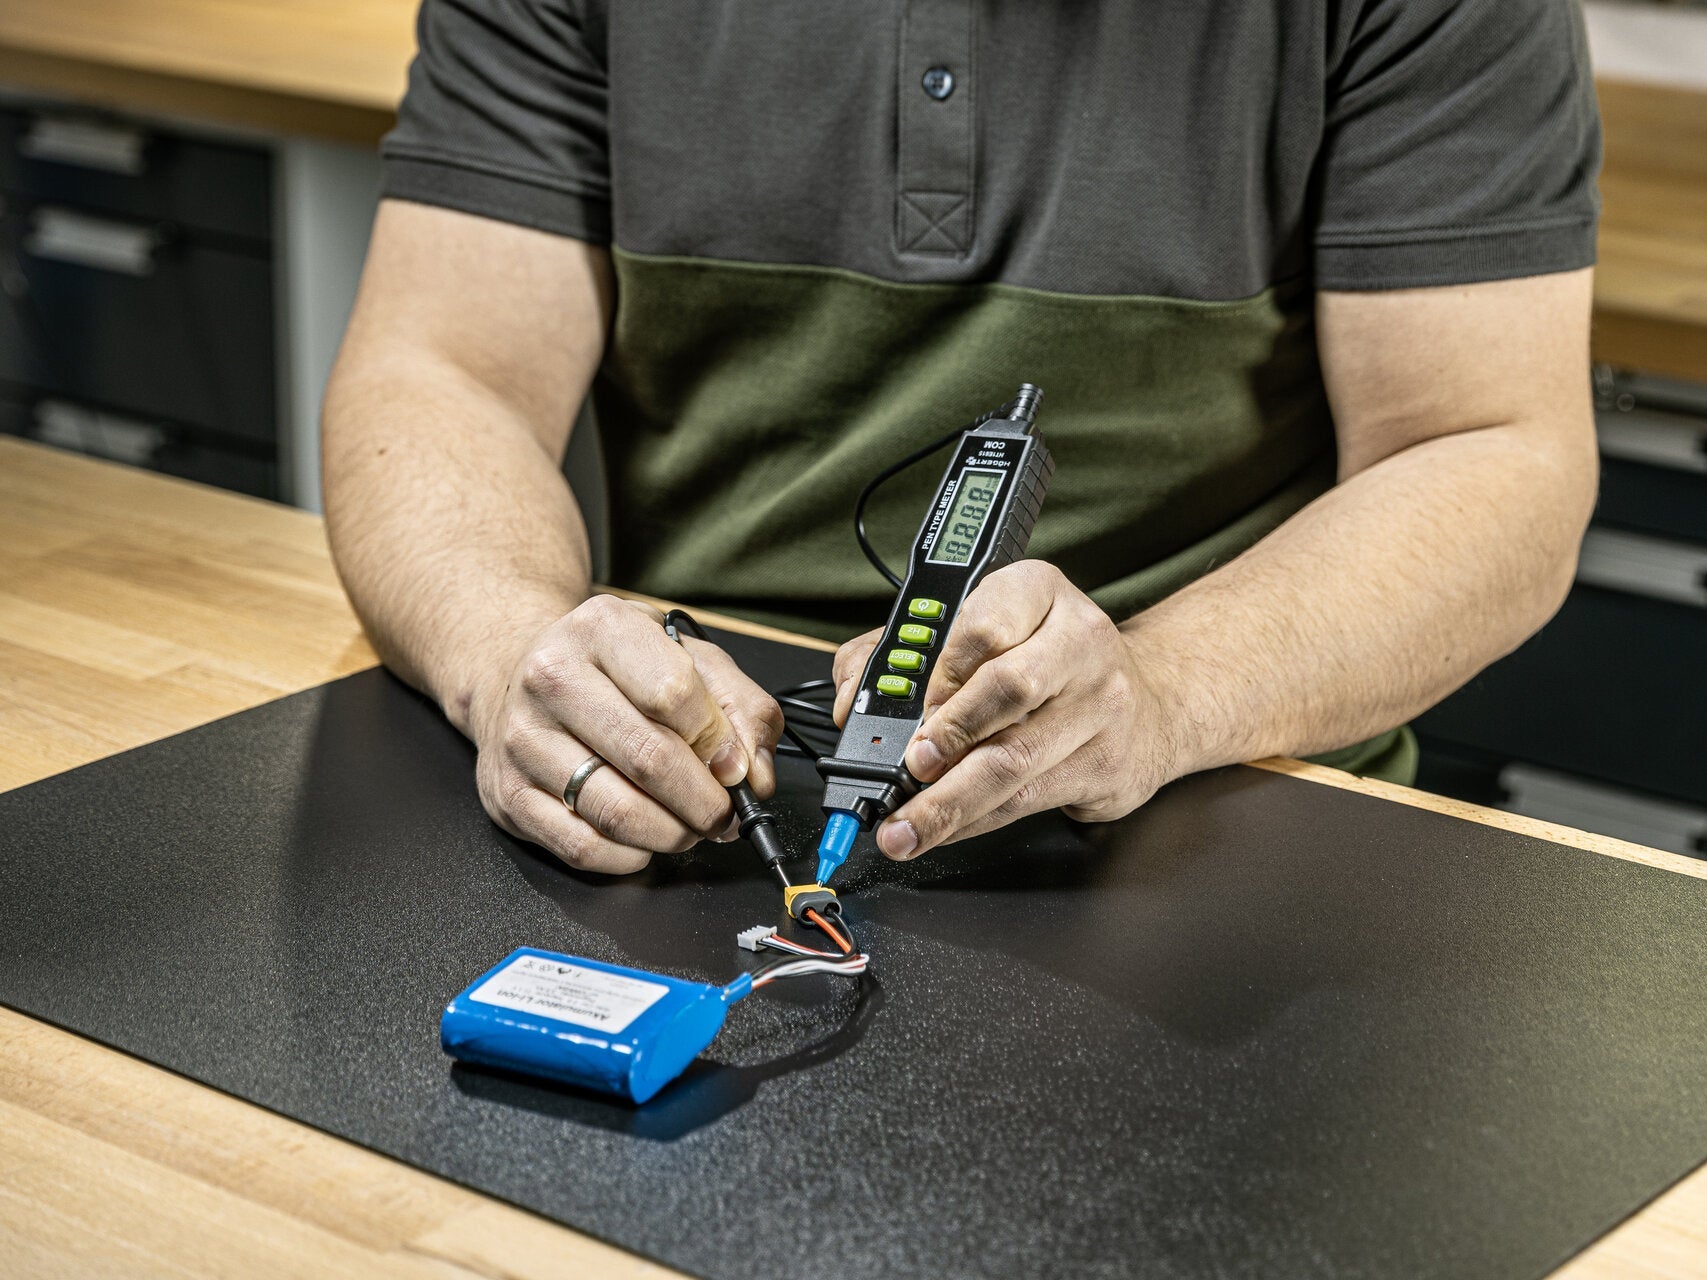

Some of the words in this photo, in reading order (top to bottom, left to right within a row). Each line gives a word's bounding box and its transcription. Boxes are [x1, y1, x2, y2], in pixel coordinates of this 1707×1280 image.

[983, 440, 1006, 450] COM
[921, 534, 934, 550] PEN
[929, 509, 944, 533] TYPE
[939, 480, 957, 510] METER
[907, 626, 921, 635] Hz
[890, 651, 916, 661] SELECT
[537, 998, 611, 1022] Akumulator
